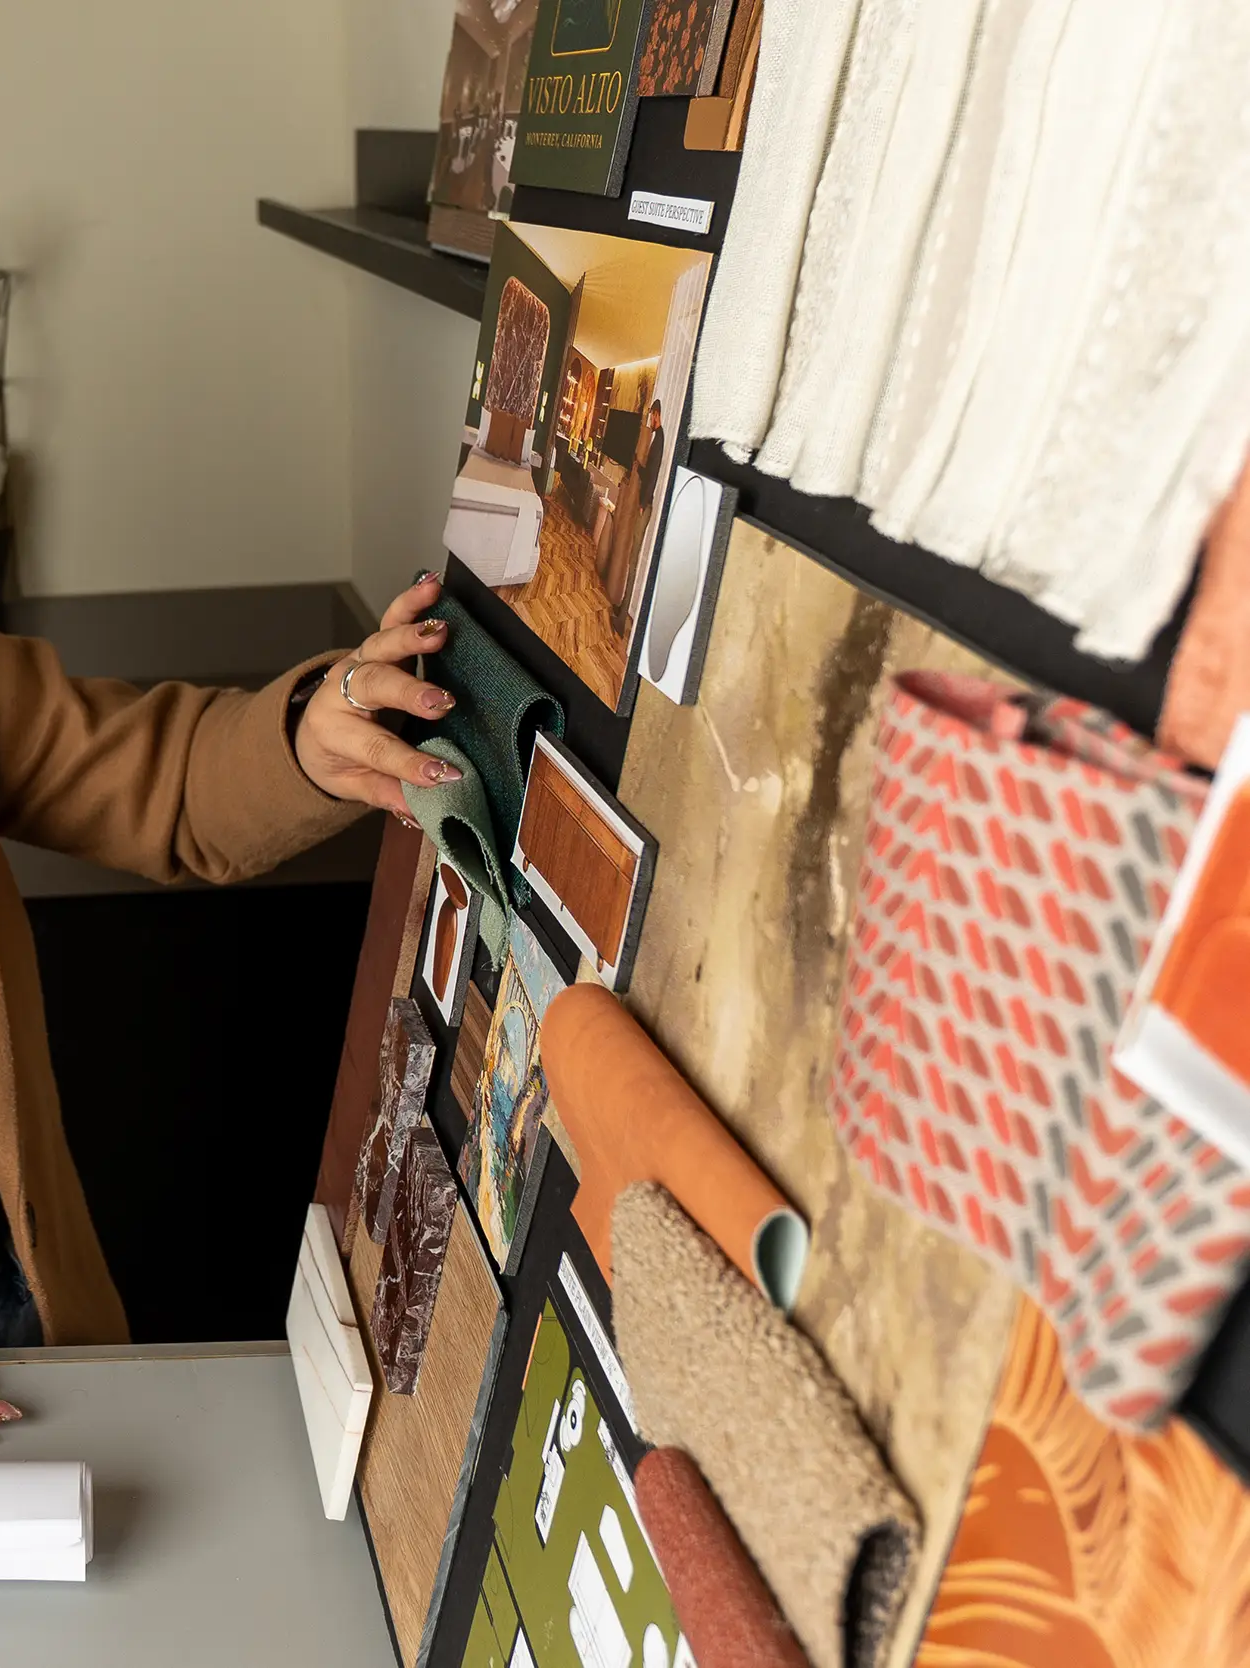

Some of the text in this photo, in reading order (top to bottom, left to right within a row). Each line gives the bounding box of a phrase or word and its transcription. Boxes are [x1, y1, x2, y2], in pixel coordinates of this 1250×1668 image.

[528, 70, 622, 114] VISTO ALTO
[525, 132, 603, 149] MONTEREY, CALIFORNIA
[631, 199, 704, 224] GUEST SUITE PERSPECTIVE
